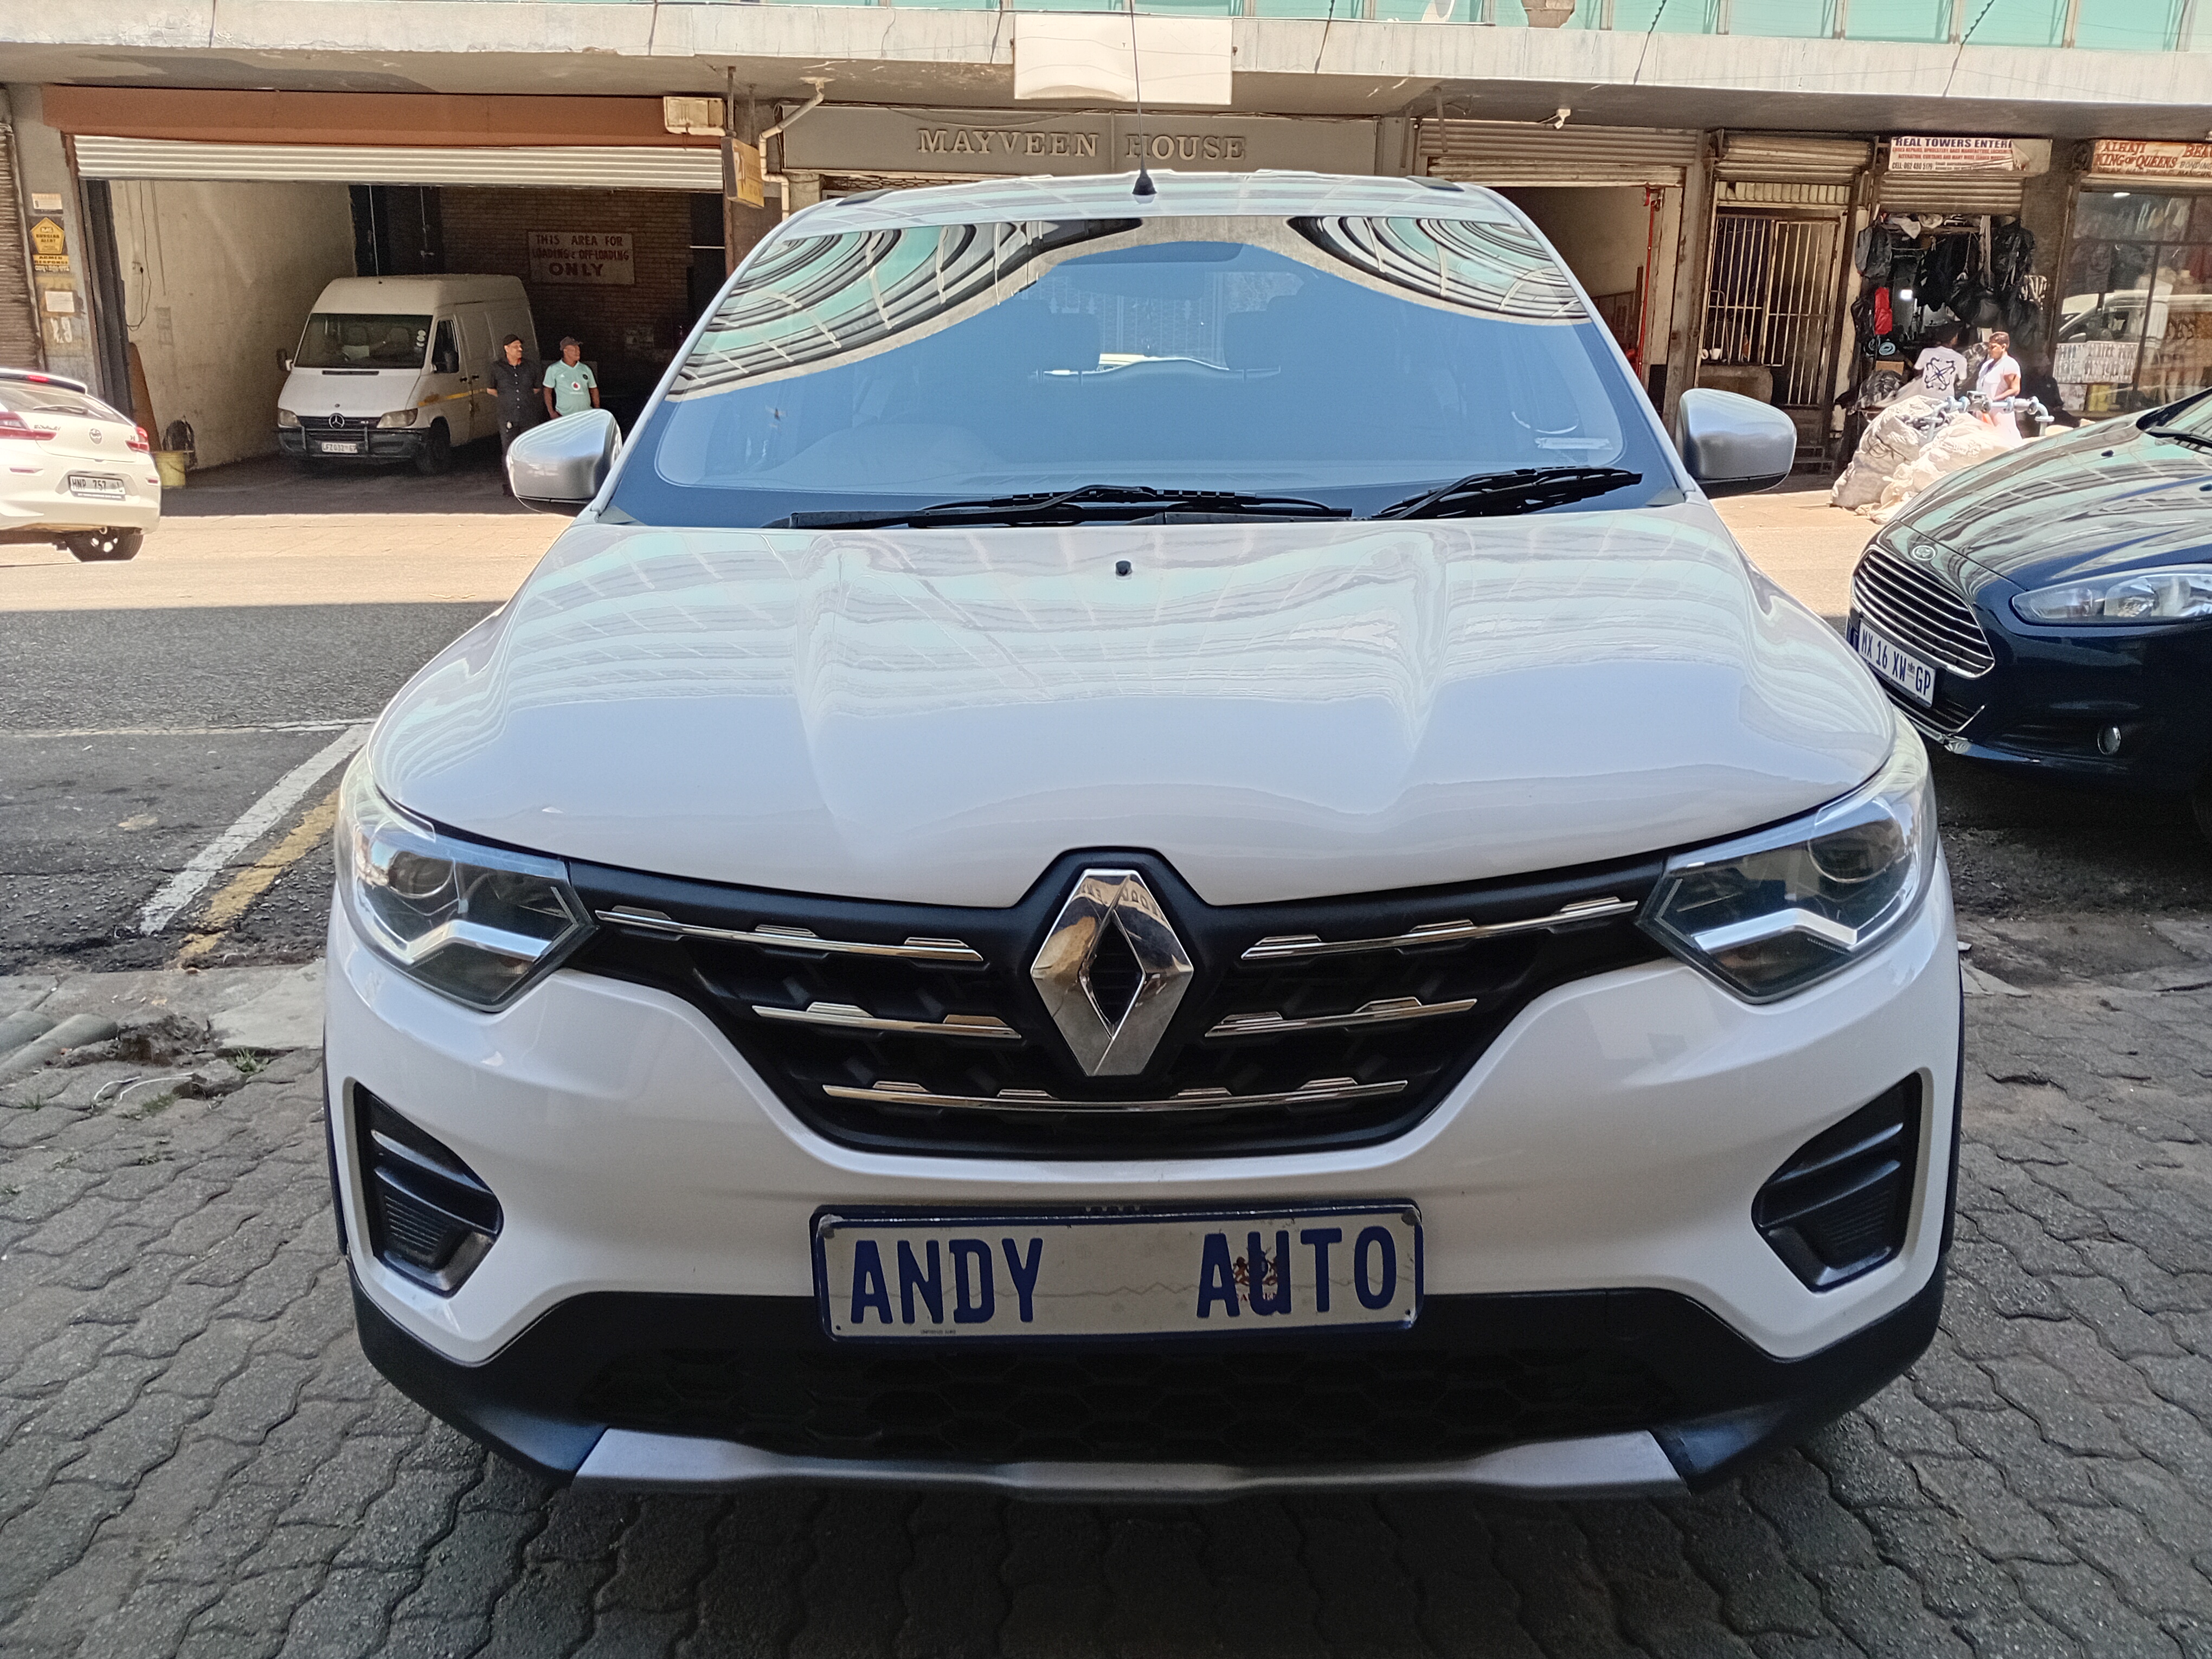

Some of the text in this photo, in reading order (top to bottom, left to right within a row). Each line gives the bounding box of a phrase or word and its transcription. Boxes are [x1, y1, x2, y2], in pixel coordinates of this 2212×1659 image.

[918, 128, 1245, 160] MAYVEEN HOUSE
[1894, 138, 1921, 146] REAL
[1925, 138, 1971, 147] TOWERS
[2182, 144, 2212, 158] BEA
[2093, 153, 2125, 166] KING
[2136, 155, 2178, 170] QUEENS
[536, 234, 623, 247] THIS AREA FOR
[532, 247, 569, 259] LOADING
[549, 262, 603, 276] ONLY
[72, 478, 87, 490] HNP
[92, 480, 106, 491] 757
[1876, 640, 1888, 670] 16
[1892, 651, 1907, 682] XW
[1915, 666, 1931, 696] GP
[850, 1225, 1397, 1324] ANDY AUTO
